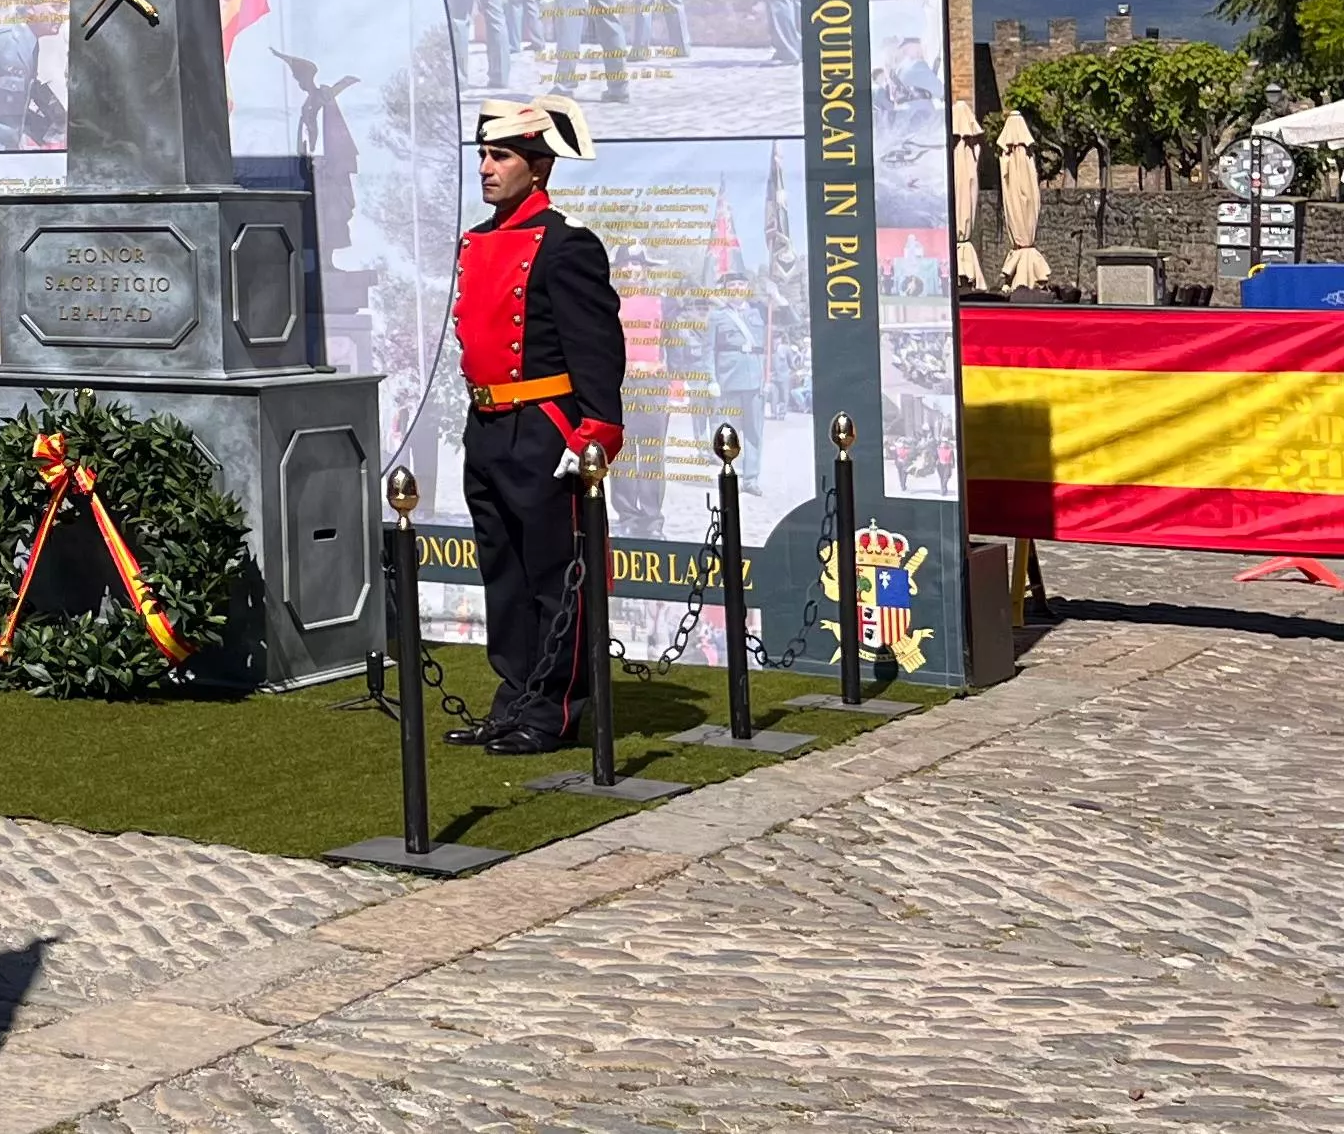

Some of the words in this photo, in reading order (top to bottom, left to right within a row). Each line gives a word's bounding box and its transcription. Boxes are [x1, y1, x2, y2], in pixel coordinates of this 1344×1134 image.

[823, 182, 858, 217] IN
[66, 248, 146, 264] HONOR
[45, 275, 171, 293] SACRIFICIO
[825, 234, 861, 320] PACE
[58, 306, 152, 323] LEALTAD
[415, 535, 478, 569] ONOR
[613, 549, 662, 584] DER
[668, 554, 702, 586] LA
[706, 556, 753, 590] PZ
